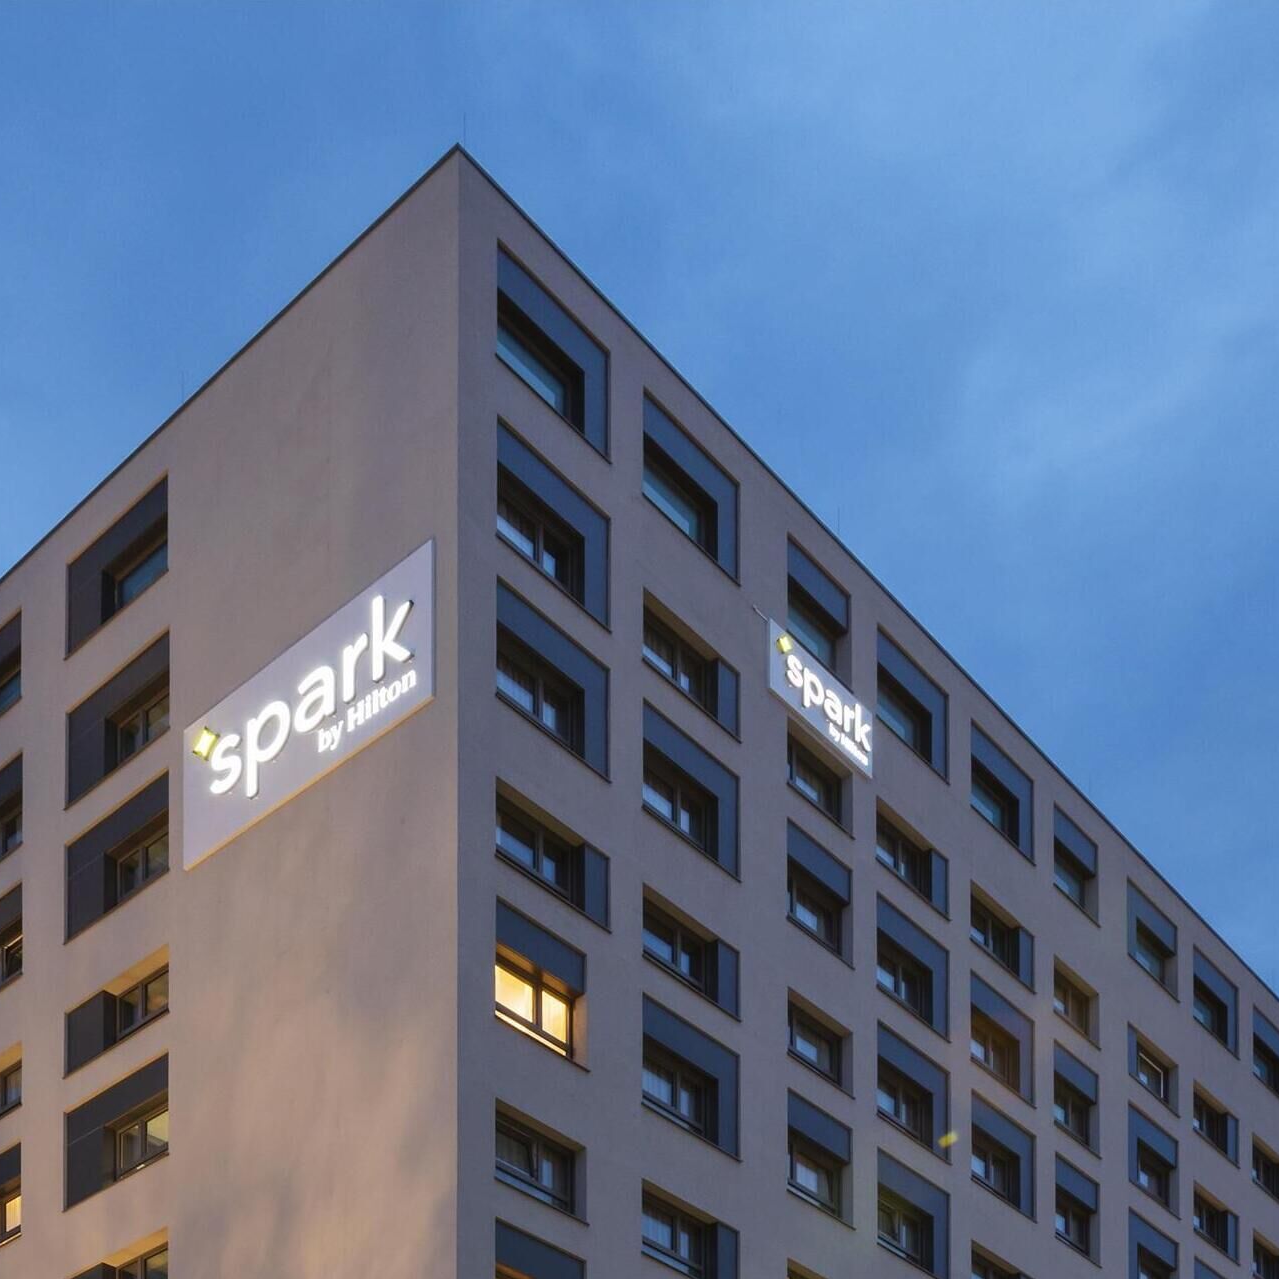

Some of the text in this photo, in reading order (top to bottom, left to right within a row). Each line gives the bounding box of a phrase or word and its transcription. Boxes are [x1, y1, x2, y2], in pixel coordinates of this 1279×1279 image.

[210, 594, 415, 800] spark
[317, 669, 417, 753] by Hilton
[786, 654, 872, 752] spark
